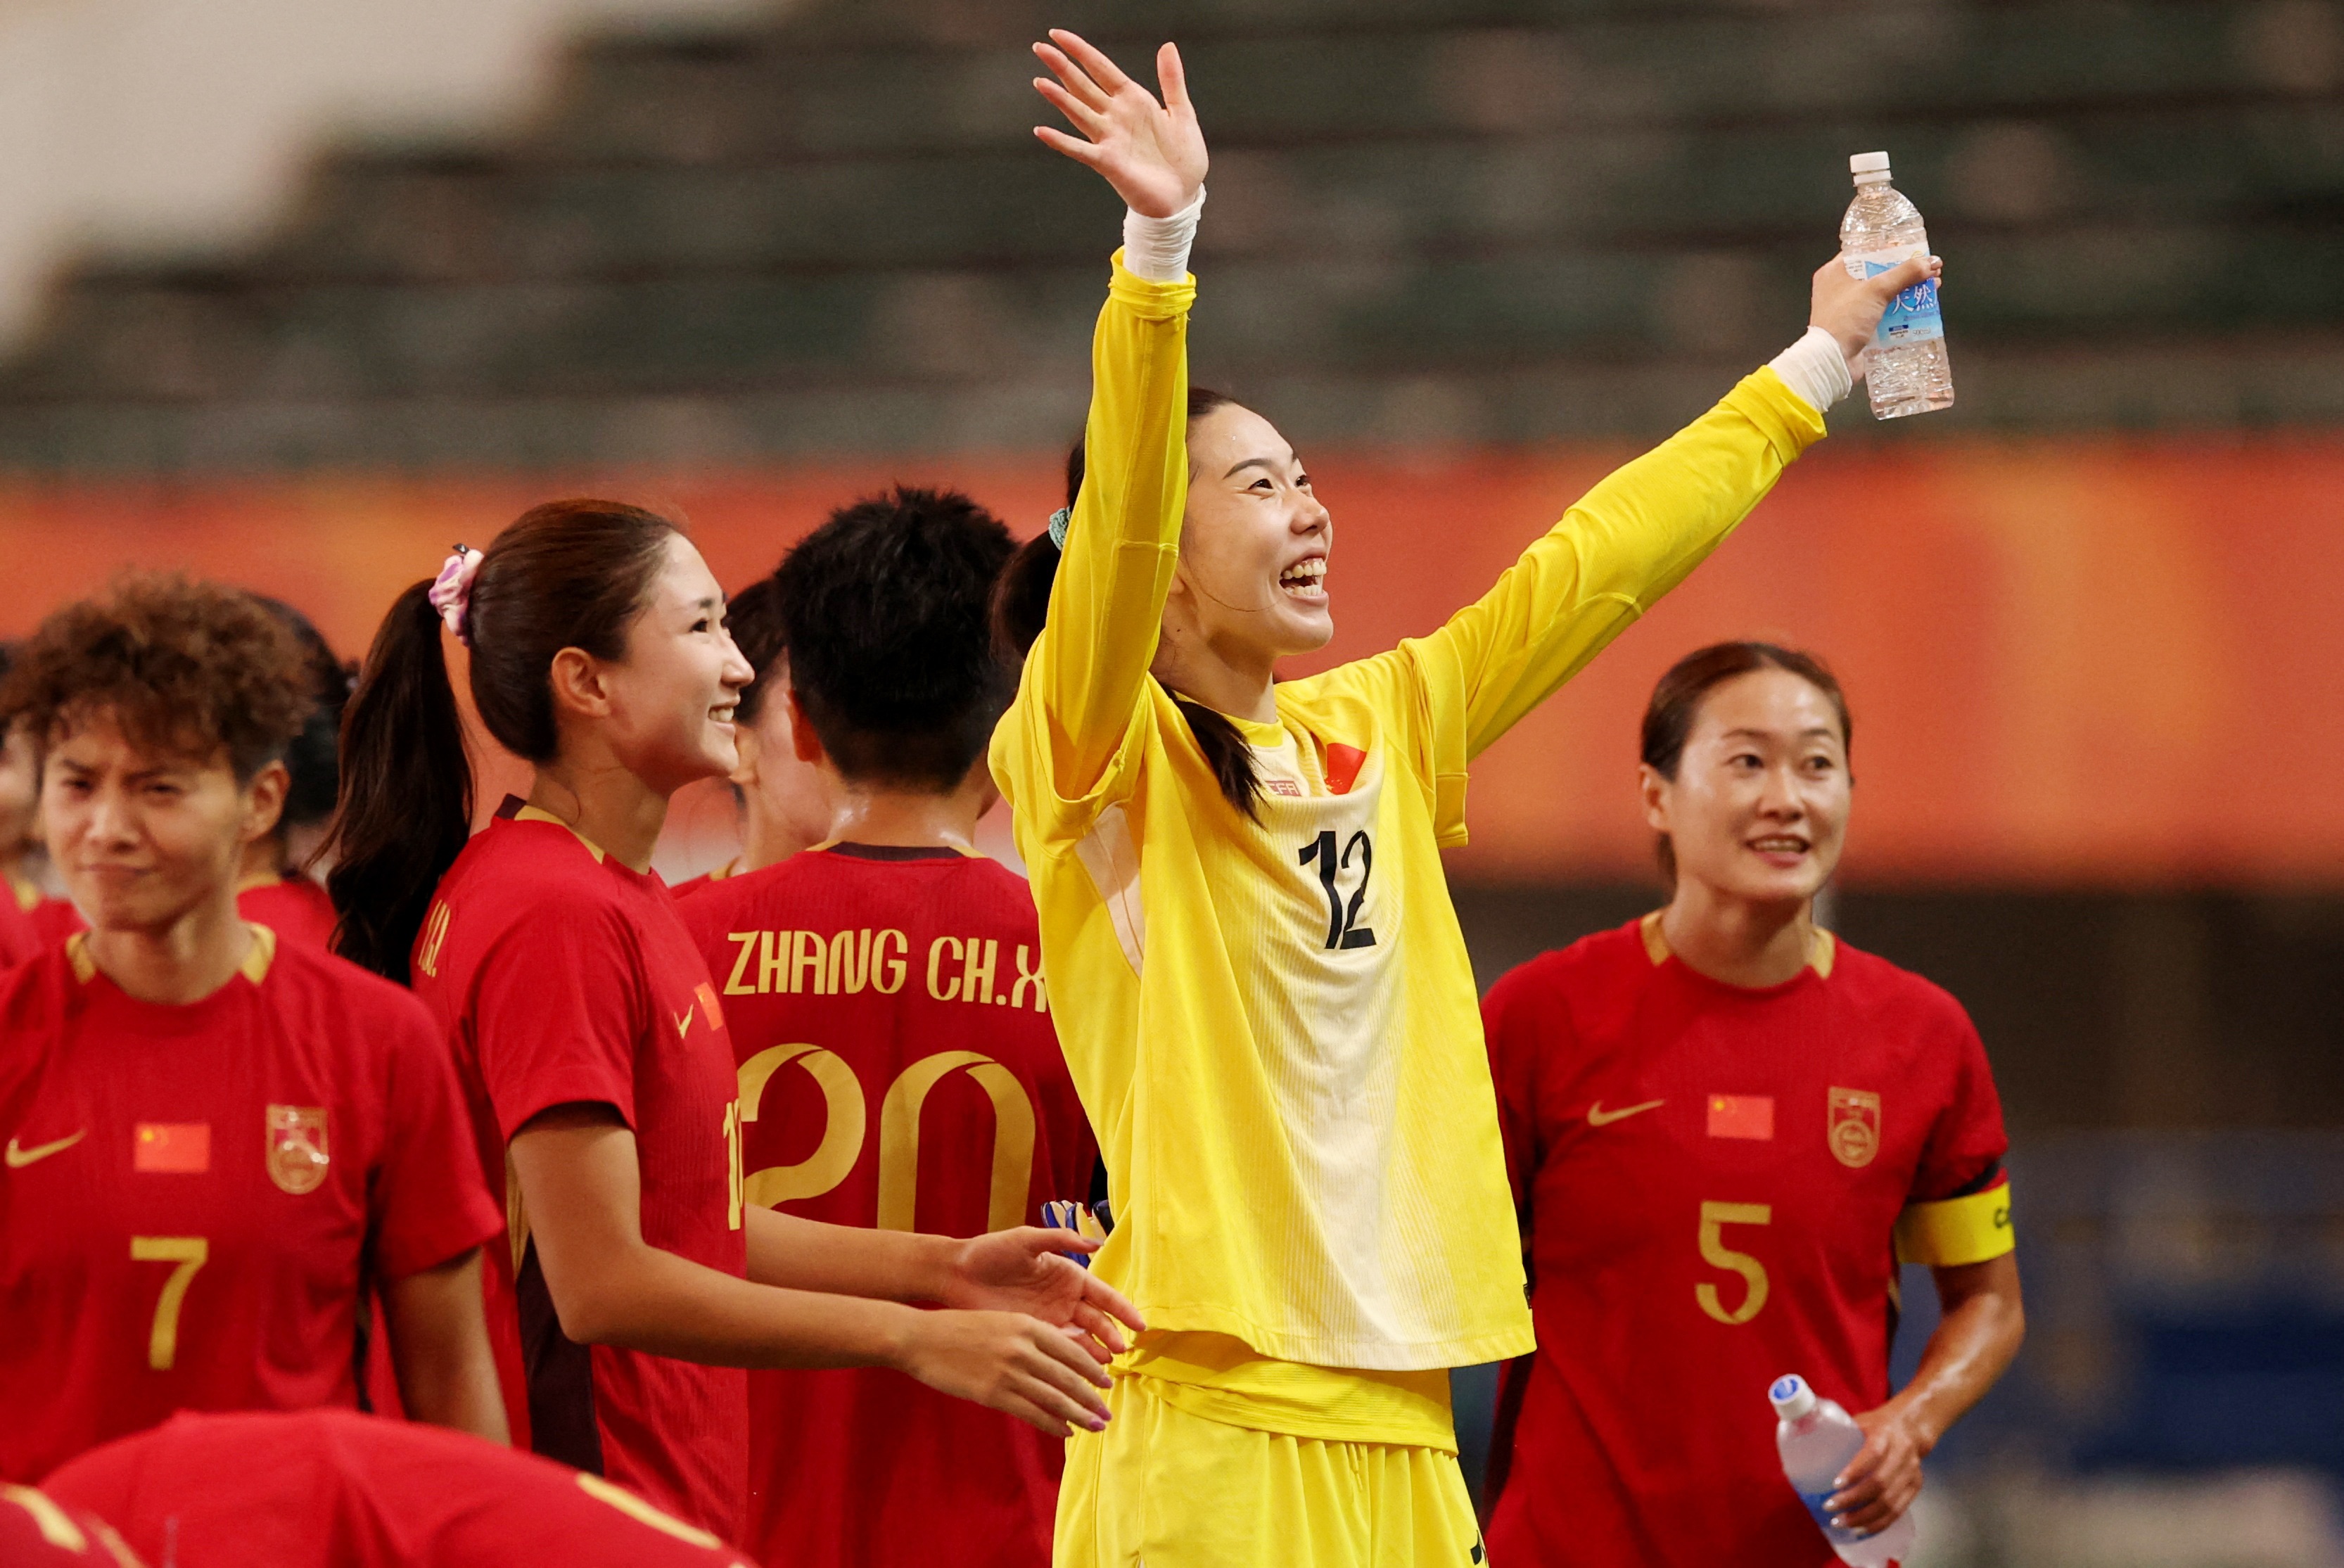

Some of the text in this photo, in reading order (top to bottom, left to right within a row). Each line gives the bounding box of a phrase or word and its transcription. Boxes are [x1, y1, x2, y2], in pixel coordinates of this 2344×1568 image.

[1892, 283, 1938, 314] 天然
[1298, 830, 1377, 950] 12
[723, 929, 1048, 1013] ZHANG CH.X
[737, 1043, 1036, 1234] 20
[130, 1237, 208, 1370] 7
[1695, 1200, 1772, 1325] 5
